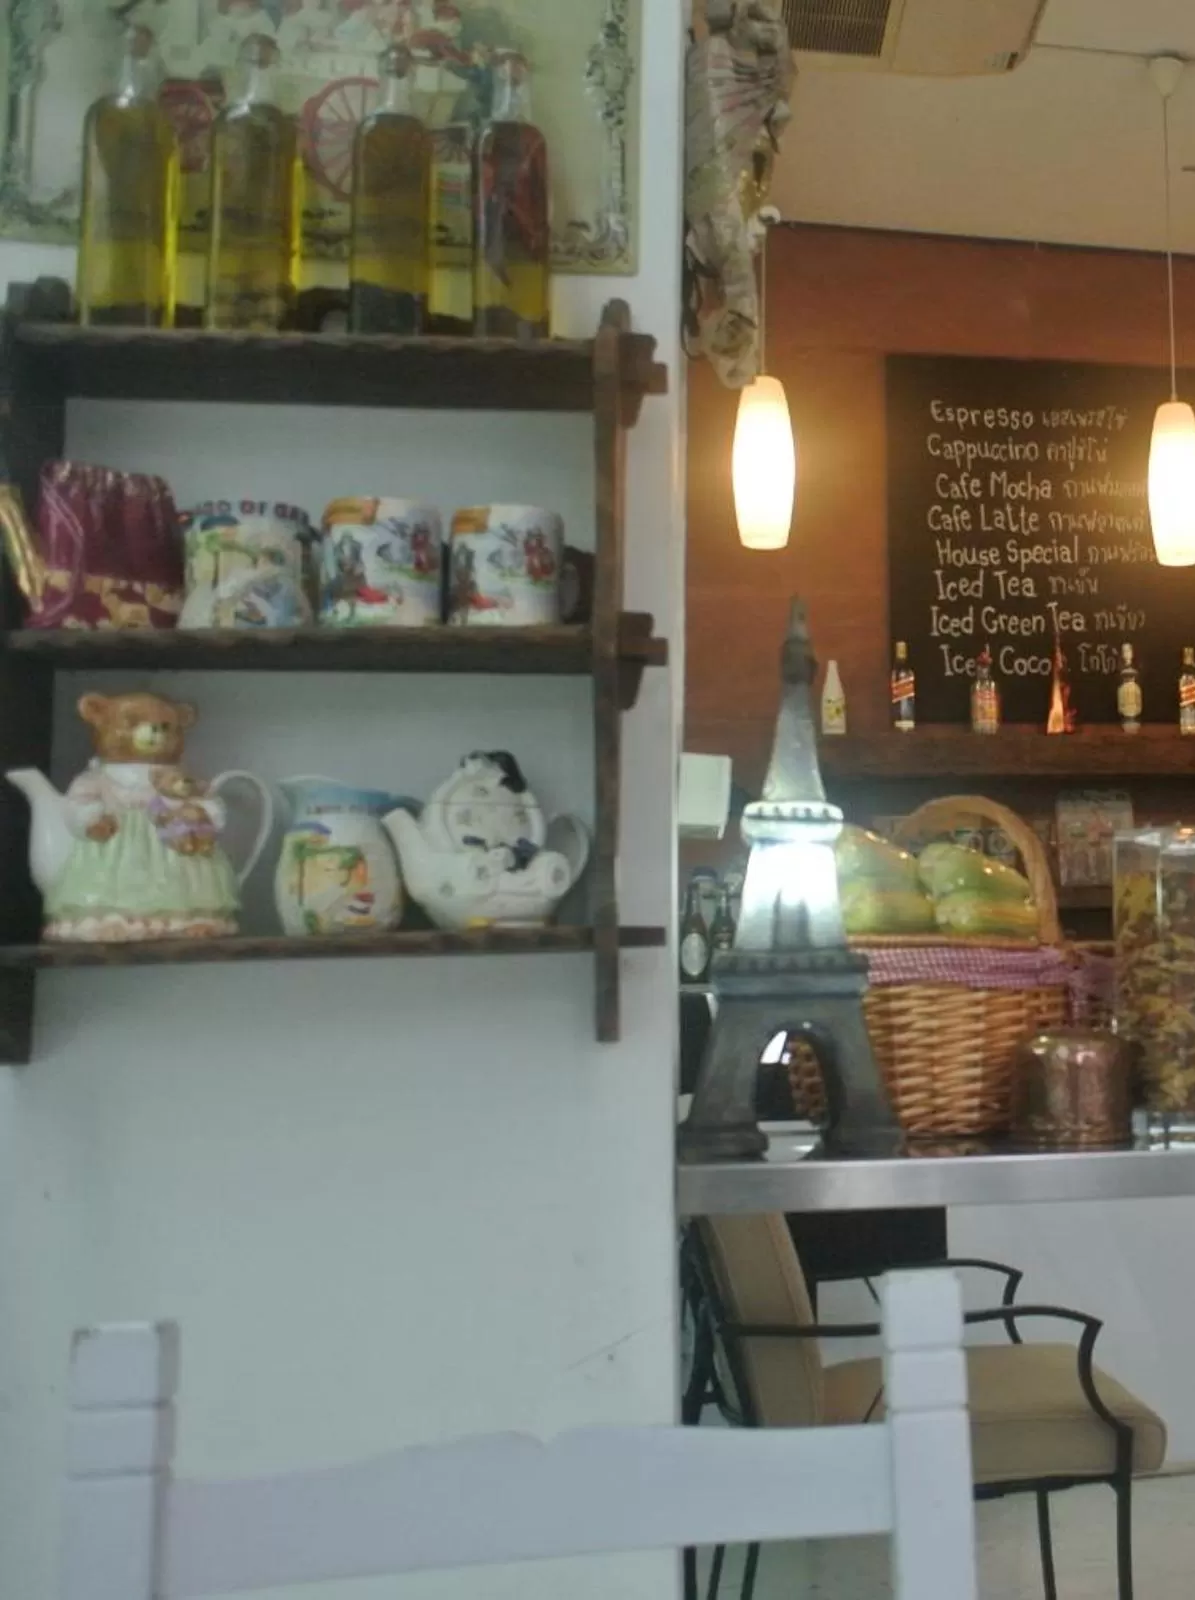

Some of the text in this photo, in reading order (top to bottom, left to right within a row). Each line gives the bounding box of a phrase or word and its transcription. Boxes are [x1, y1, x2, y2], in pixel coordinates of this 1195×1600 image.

[930, 400, 1034, 431] Espresso
[927, 433, 1039, 471] Cappuccino
[935, 473, 982, 499] Cafe
[990, 471, 1052, 500] Mocha
[927, 504, 972, 532] Cafe
[980, 502, 1040, 536] Latte
[936, 539, 1000, 567] House
[1006, 536, 1078, 572] Special
[933, 567, 984, 601] Iced
[993, 570, 1037, 600] Tea
[930, 605, 974, 637] Iced
[981, 605, 1045, 637] Green
[1046, 601, 1087, 632] Tea
[939, 643, 989, 677] Ice
